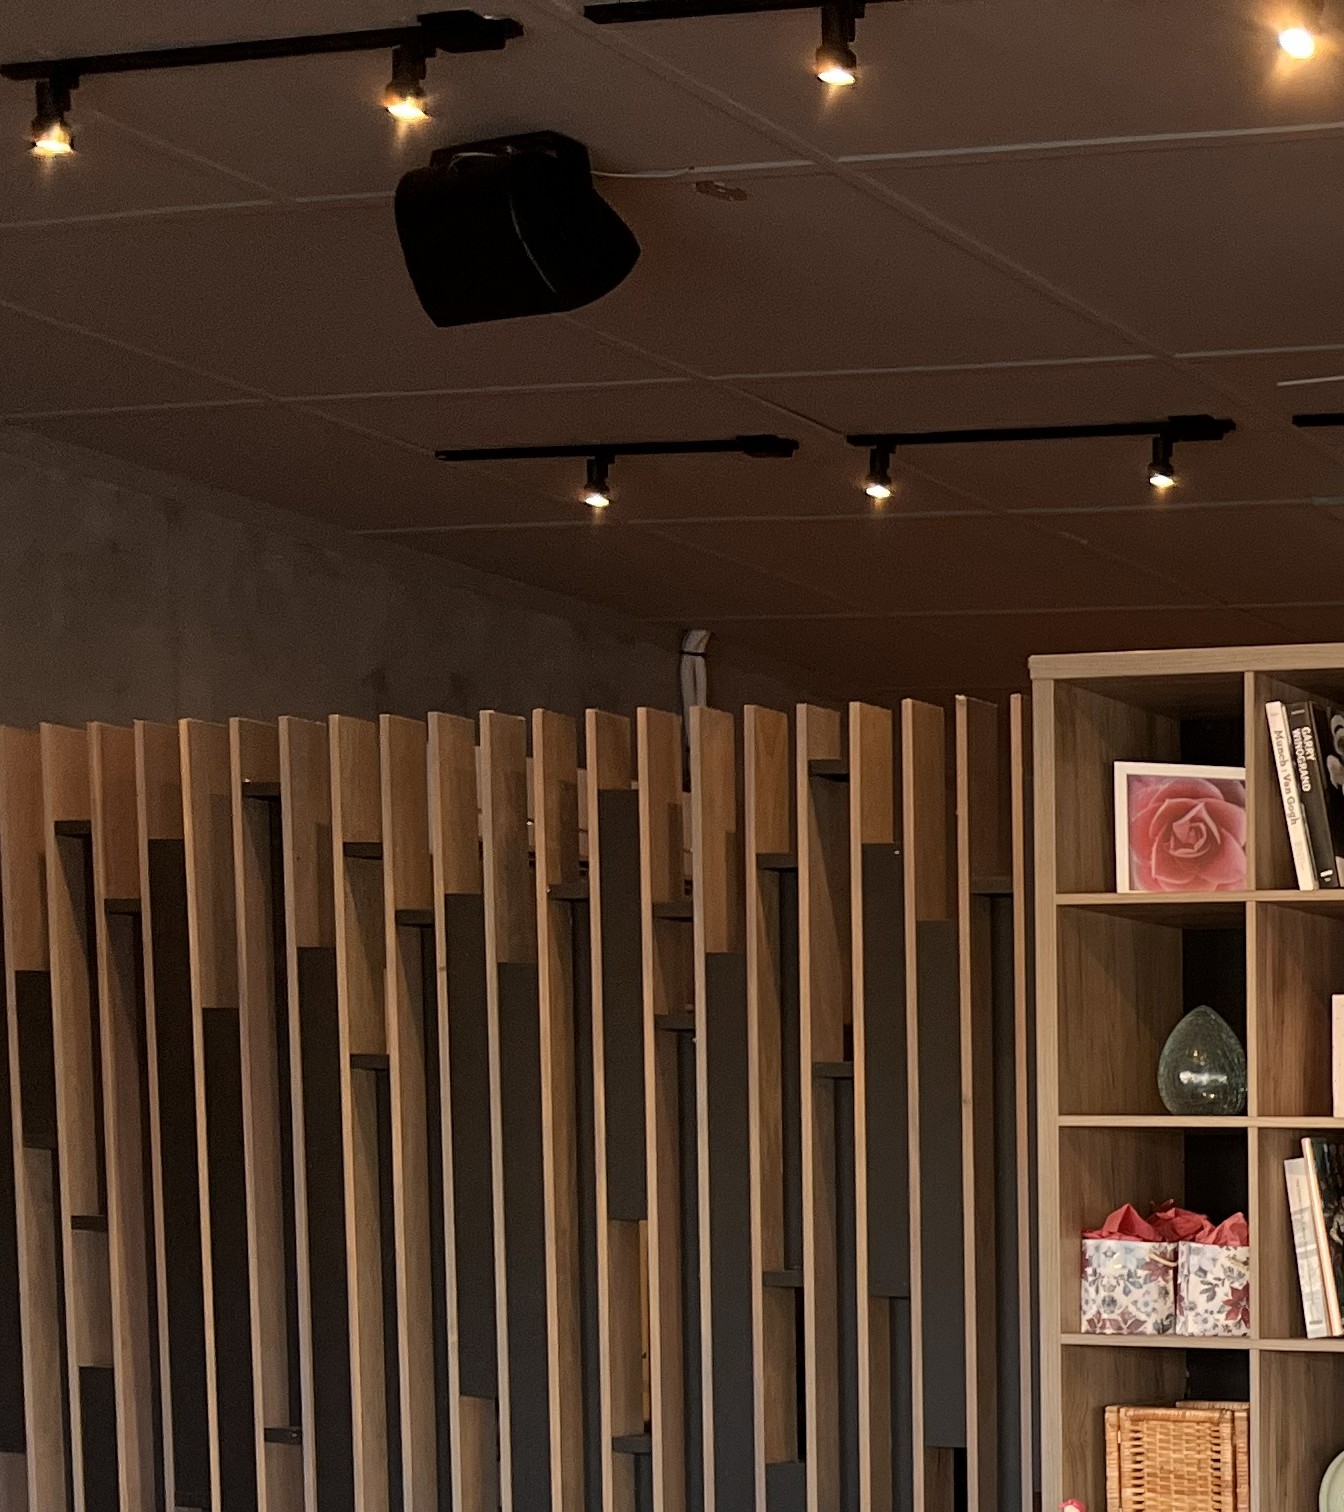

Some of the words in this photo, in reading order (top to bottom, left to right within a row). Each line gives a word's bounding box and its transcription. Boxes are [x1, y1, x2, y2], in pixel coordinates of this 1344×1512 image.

[1273, 729, 1290, 767] Munch
[1292, 728, 1312, 792] WINOGRAND
[1301, 726, 1316, 762] GARRY
[1283, 773, 1294, 794] Van
[1287, 795, 1301, 826] Gogh
